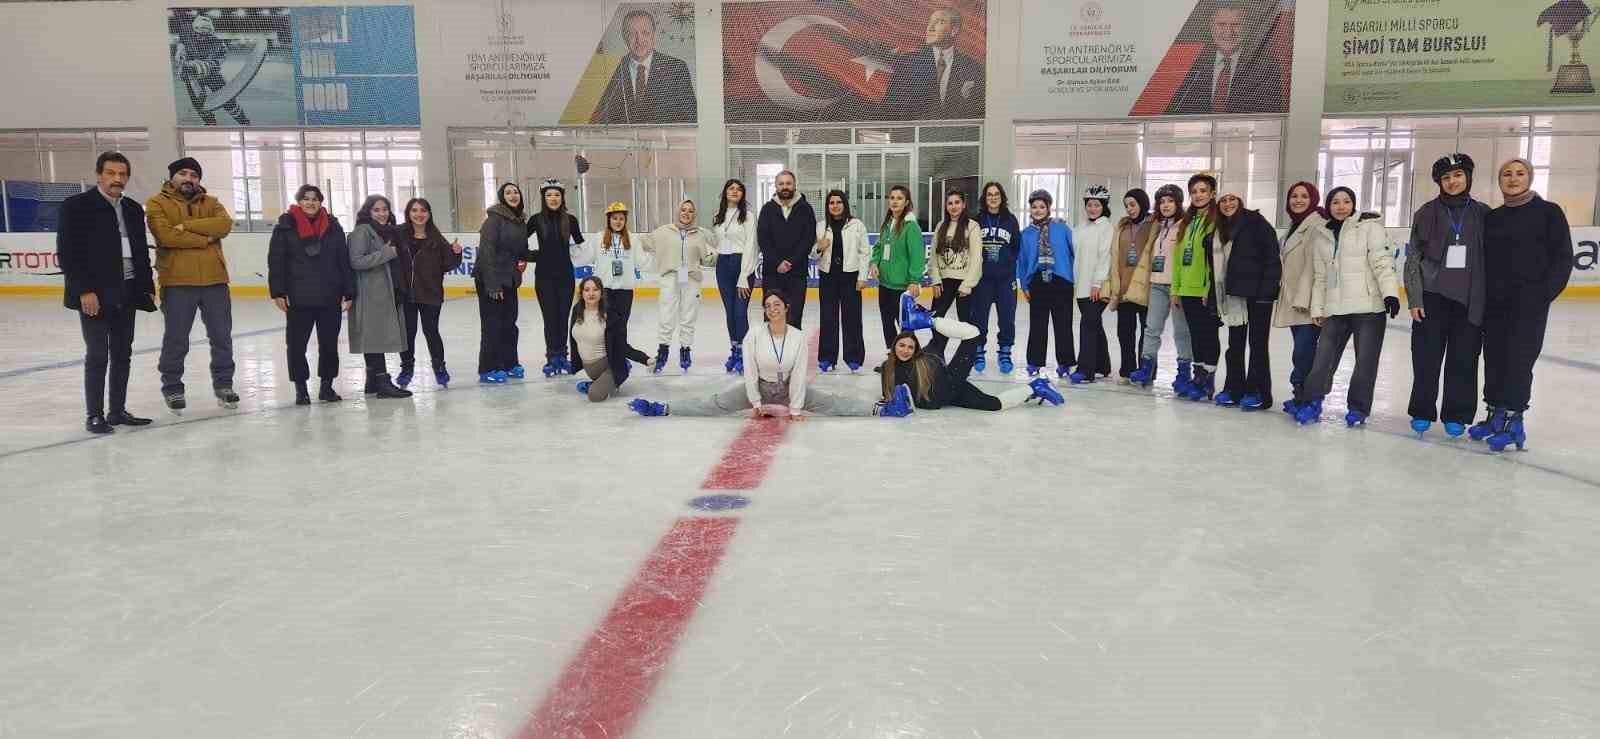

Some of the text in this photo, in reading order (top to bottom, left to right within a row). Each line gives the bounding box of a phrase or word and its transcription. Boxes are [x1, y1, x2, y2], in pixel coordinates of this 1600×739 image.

[1390, 17, 1416, 32] MİLLİ
[1418, 17, 1460, 31] SPORCU
[1343, 34, 1487, 57] ŞİMDİ TAM BURSLU!
